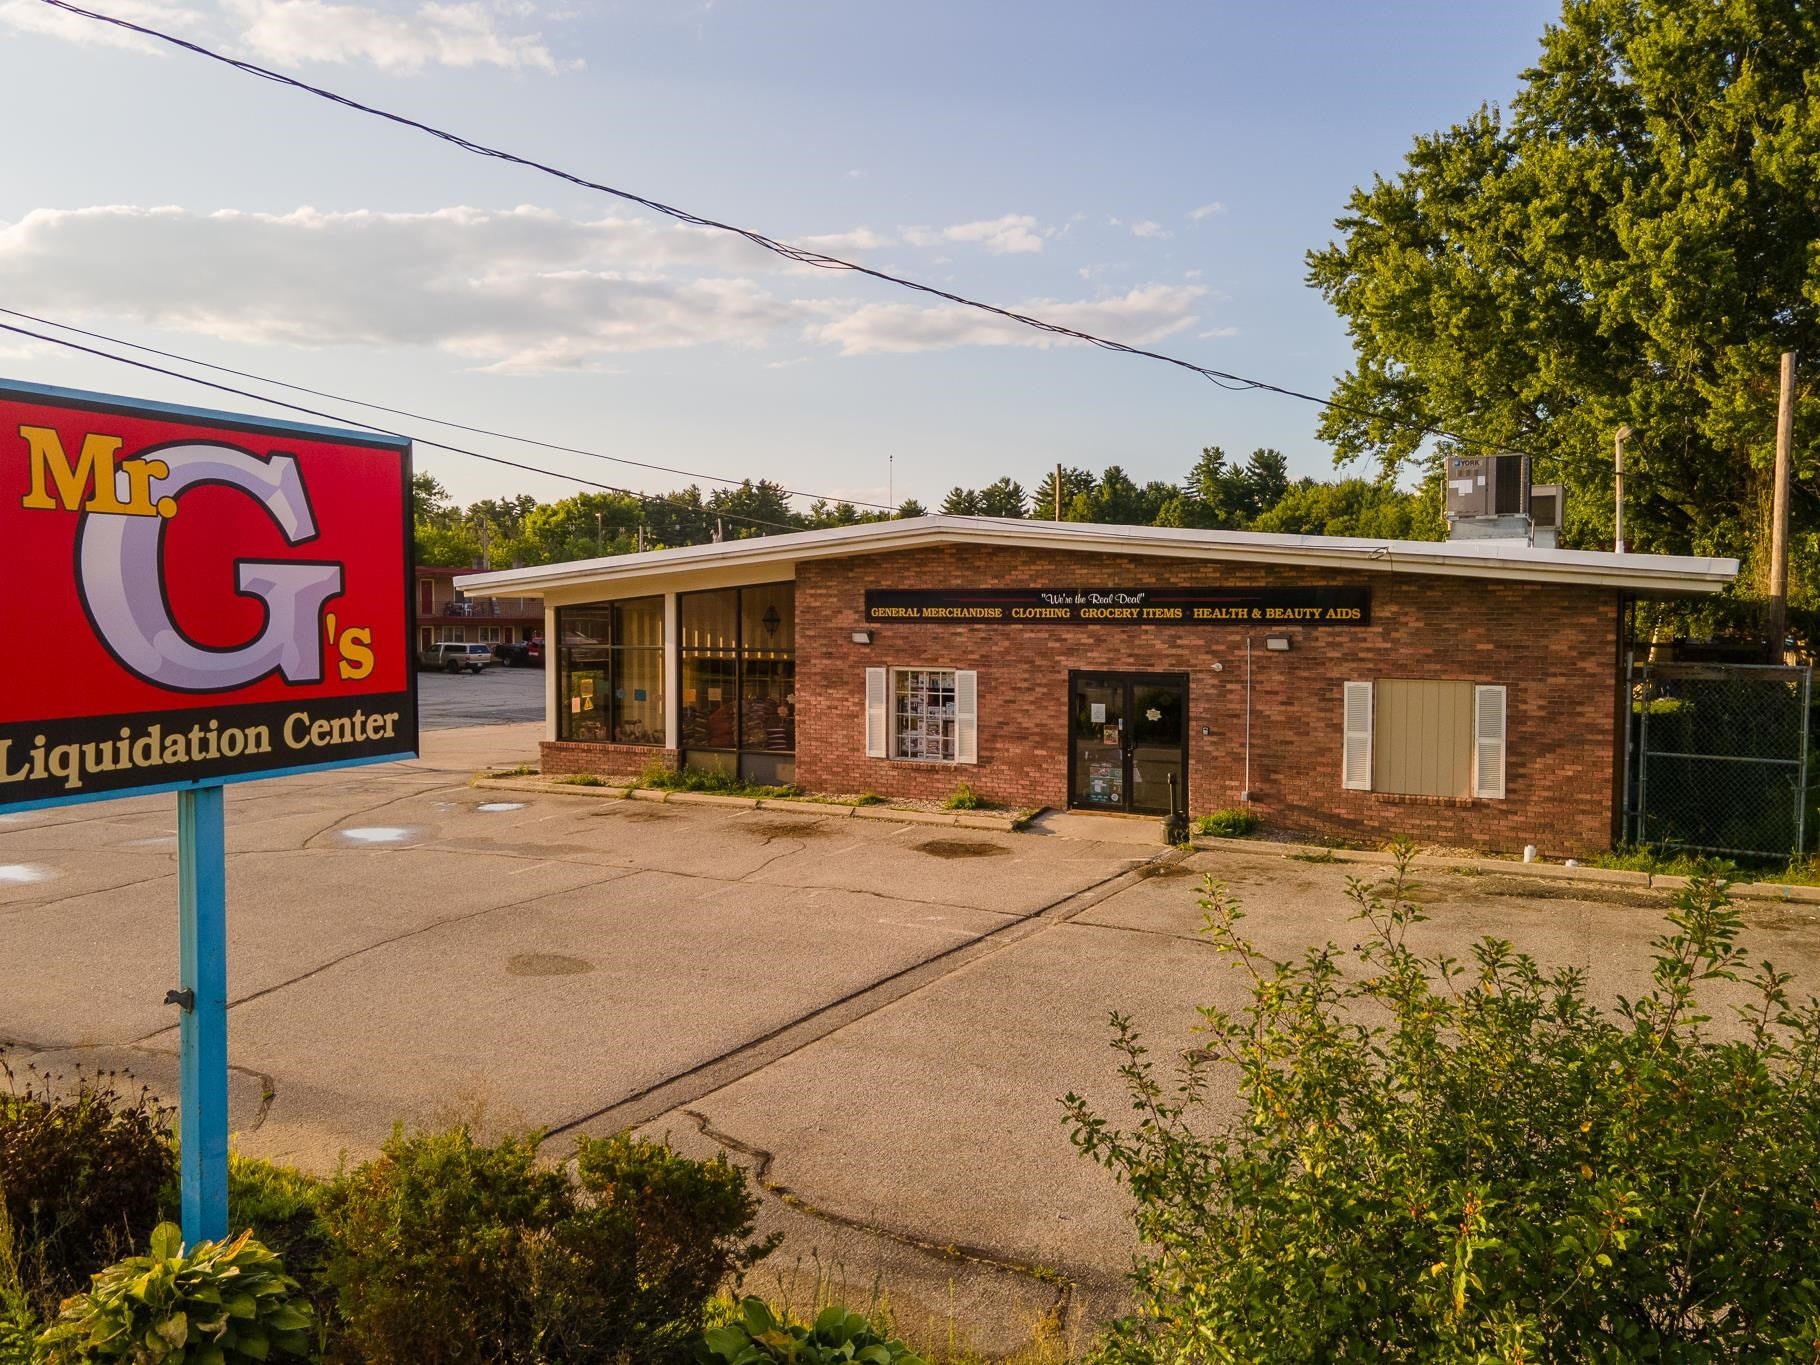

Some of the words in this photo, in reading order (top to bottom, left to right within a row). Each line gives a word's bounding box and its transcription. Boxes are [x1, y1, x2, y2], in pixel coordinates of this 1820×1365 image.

[18, 425, 178, 518] Mr.
[871, 607, 920, 618] GENERAL
[922, 607, 1002, 618] MERCHANDISE
[1012, 608, 1070, 618] CLOTHING
[1080, 608, 1138, 618] GROCERY
[1142, 608, 1182, 618] ITEMS
[1193, 608, 1248, 619] HEALTH
[1251, 608, 1262, 619] &
[1265, 608, 1322, 619] BEAUTY
[1326, 608, 1361, 619] AIDS
[1074, 593, 1086, 604] the
[1088, 593, 1113, 604] Real
[0, 719, 271, 789] Liquidation
[283, 710, 399, 750] Center
